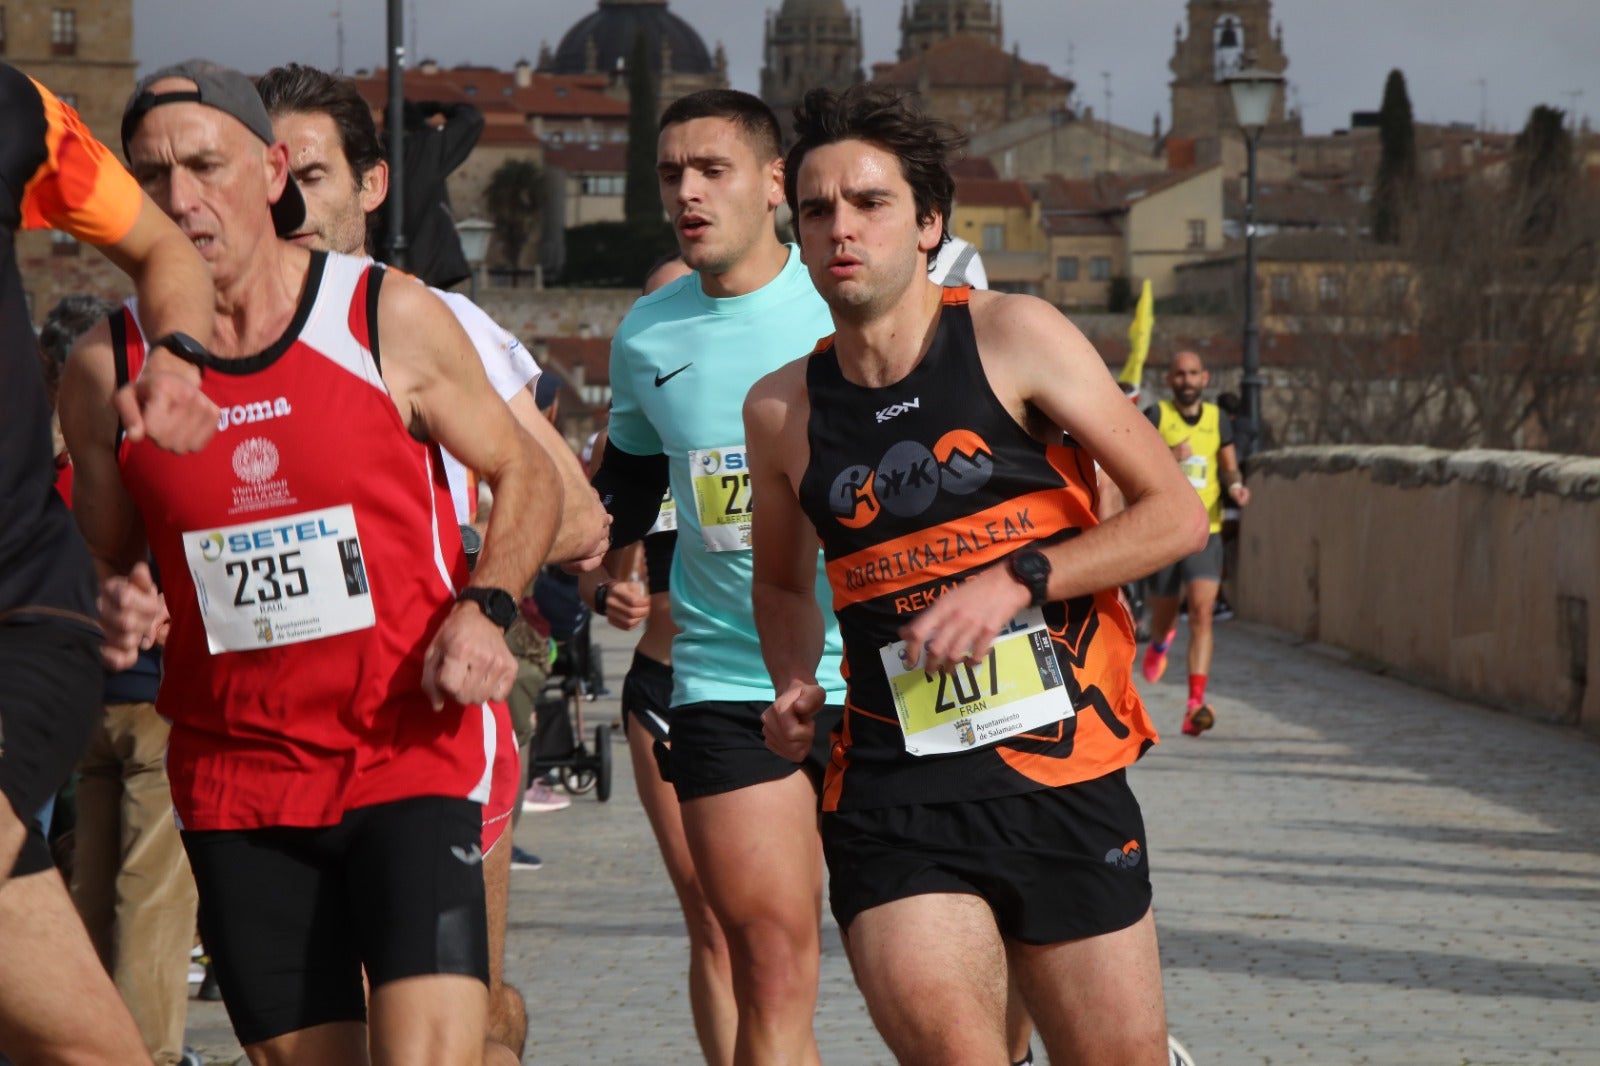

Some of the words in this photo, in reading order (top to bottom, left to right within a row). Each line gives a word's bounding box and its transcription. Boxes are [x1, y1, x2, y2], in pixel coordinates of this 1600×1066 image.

[228, 518, 339, 553] SETEL
[846, 508, 1035, 591] KORRIKAZALEAK
[225, 551, 309, 607] 235
[959, 700, 988, 717] FRAN
[976, 713, 1020, 731] Ayuntamiento
[979, 732, 988, 741] de
[988, 722, 1023, 738] Salamanca
